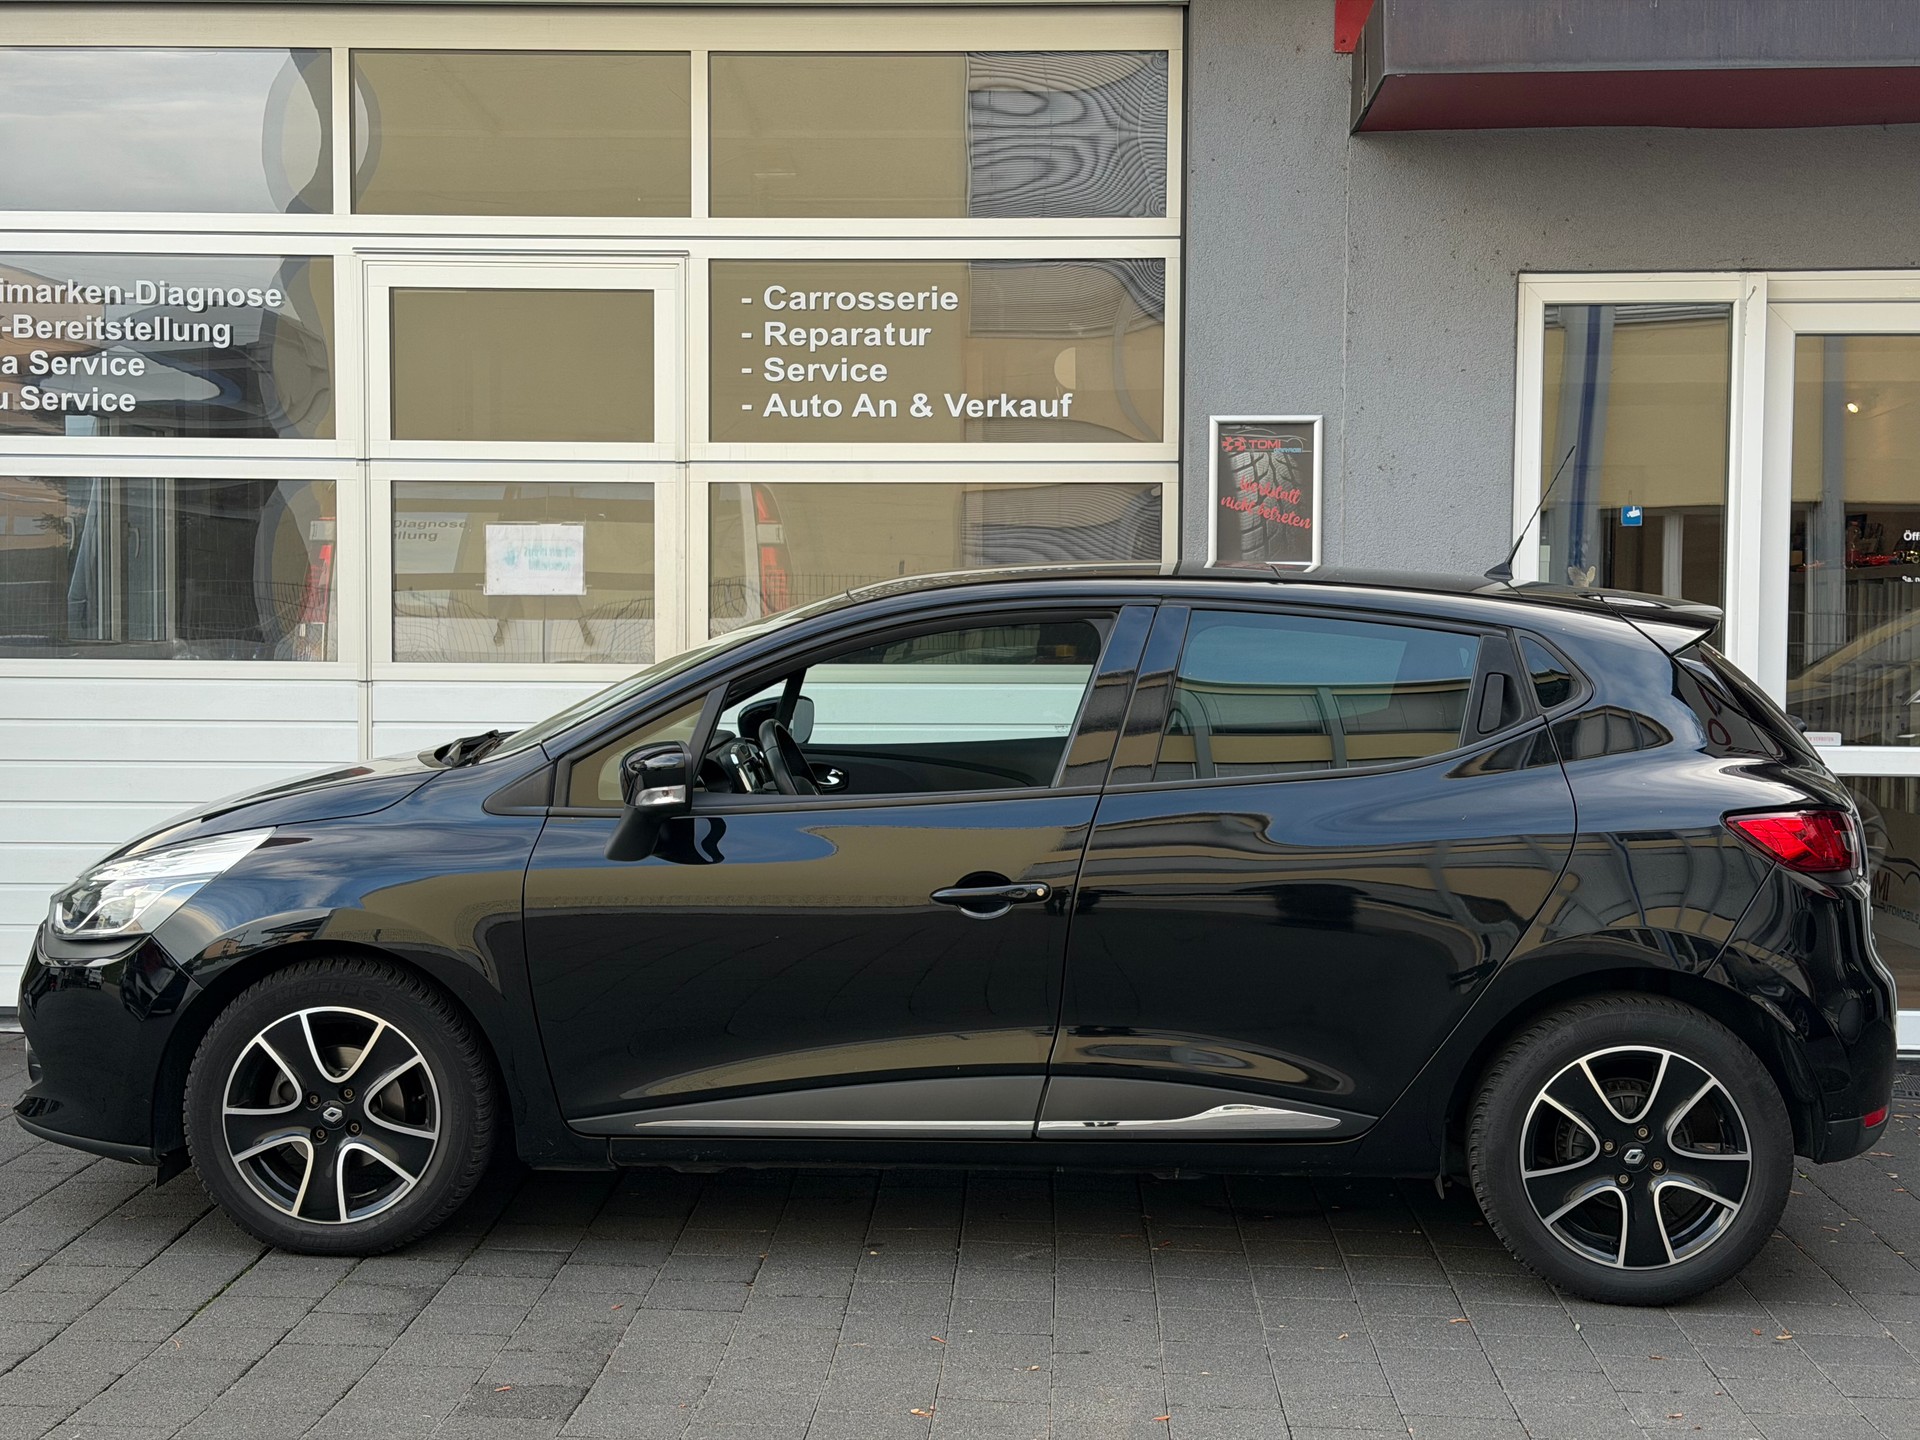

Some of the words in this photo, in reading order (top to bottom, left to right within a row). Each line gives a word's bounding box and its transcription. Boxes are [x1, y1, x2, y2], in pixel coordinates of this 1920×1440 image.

[763, 286, 959, 310] Carrosserie
[764, 321, 932, 351] Reparatur
[29, 350, 146, 376] Service
[764, 357, 888, 382] Service
[20, 386, 137, 412] Service
[763, 393, 843, 418] Auto
[852, 393, 897, 418] An
[909, 393, 934, 418] &
[944, 393, 1073, 418] Verkauf
[1249, 439, 1281, 449] TOMI
